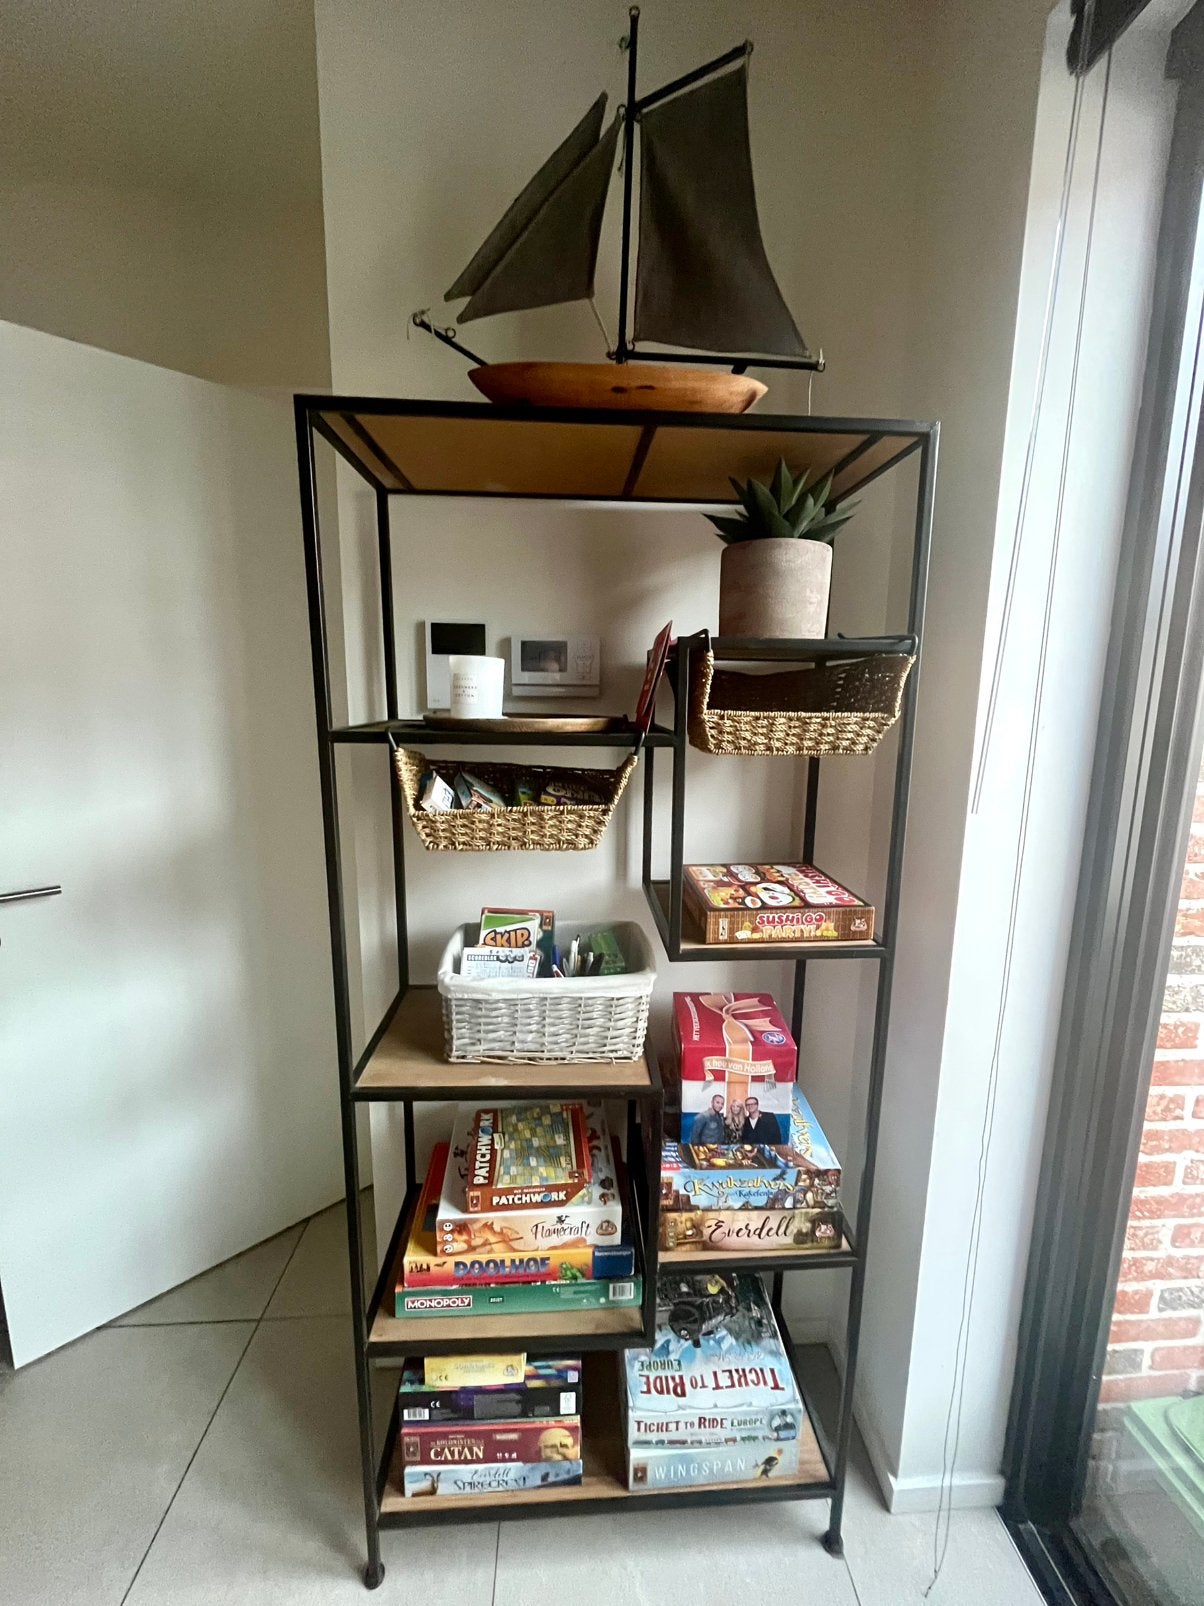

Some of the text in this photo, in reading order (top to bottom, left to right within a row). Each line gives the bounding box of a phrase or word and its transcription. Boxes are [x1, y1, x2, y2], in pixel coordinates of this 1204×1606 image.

[803, 912, 825, 925] GO
[763, 925, 816, 938] PARTY!
[473, 1112, 494, 1185] PATCHWORK
[492, 1191, 567, 1206] PATCHWORK
[531, 1220, 591, 1240] Flamecraft
[706, 1216, 795, 1243] Everdell
[454, 1257, 551, 1278] DOOLHOF
[407, 1297, 470, 1309] MONOPOLY
[638, 1358, 682, 1373] EUROPE
[639, 1367, 785, 1398] TICKET TO RIDE
[634, 1420, 681, 1434] TICKET
[684, 1421, 694, 1429] TO
[698, 1416, 727, 1430] RIDE
[730, 1418, 765, 1428] EUROPE
[429, 1446, 484, 1461] CATAN
[654, 1457, 746, 1481] WINGSPAN
